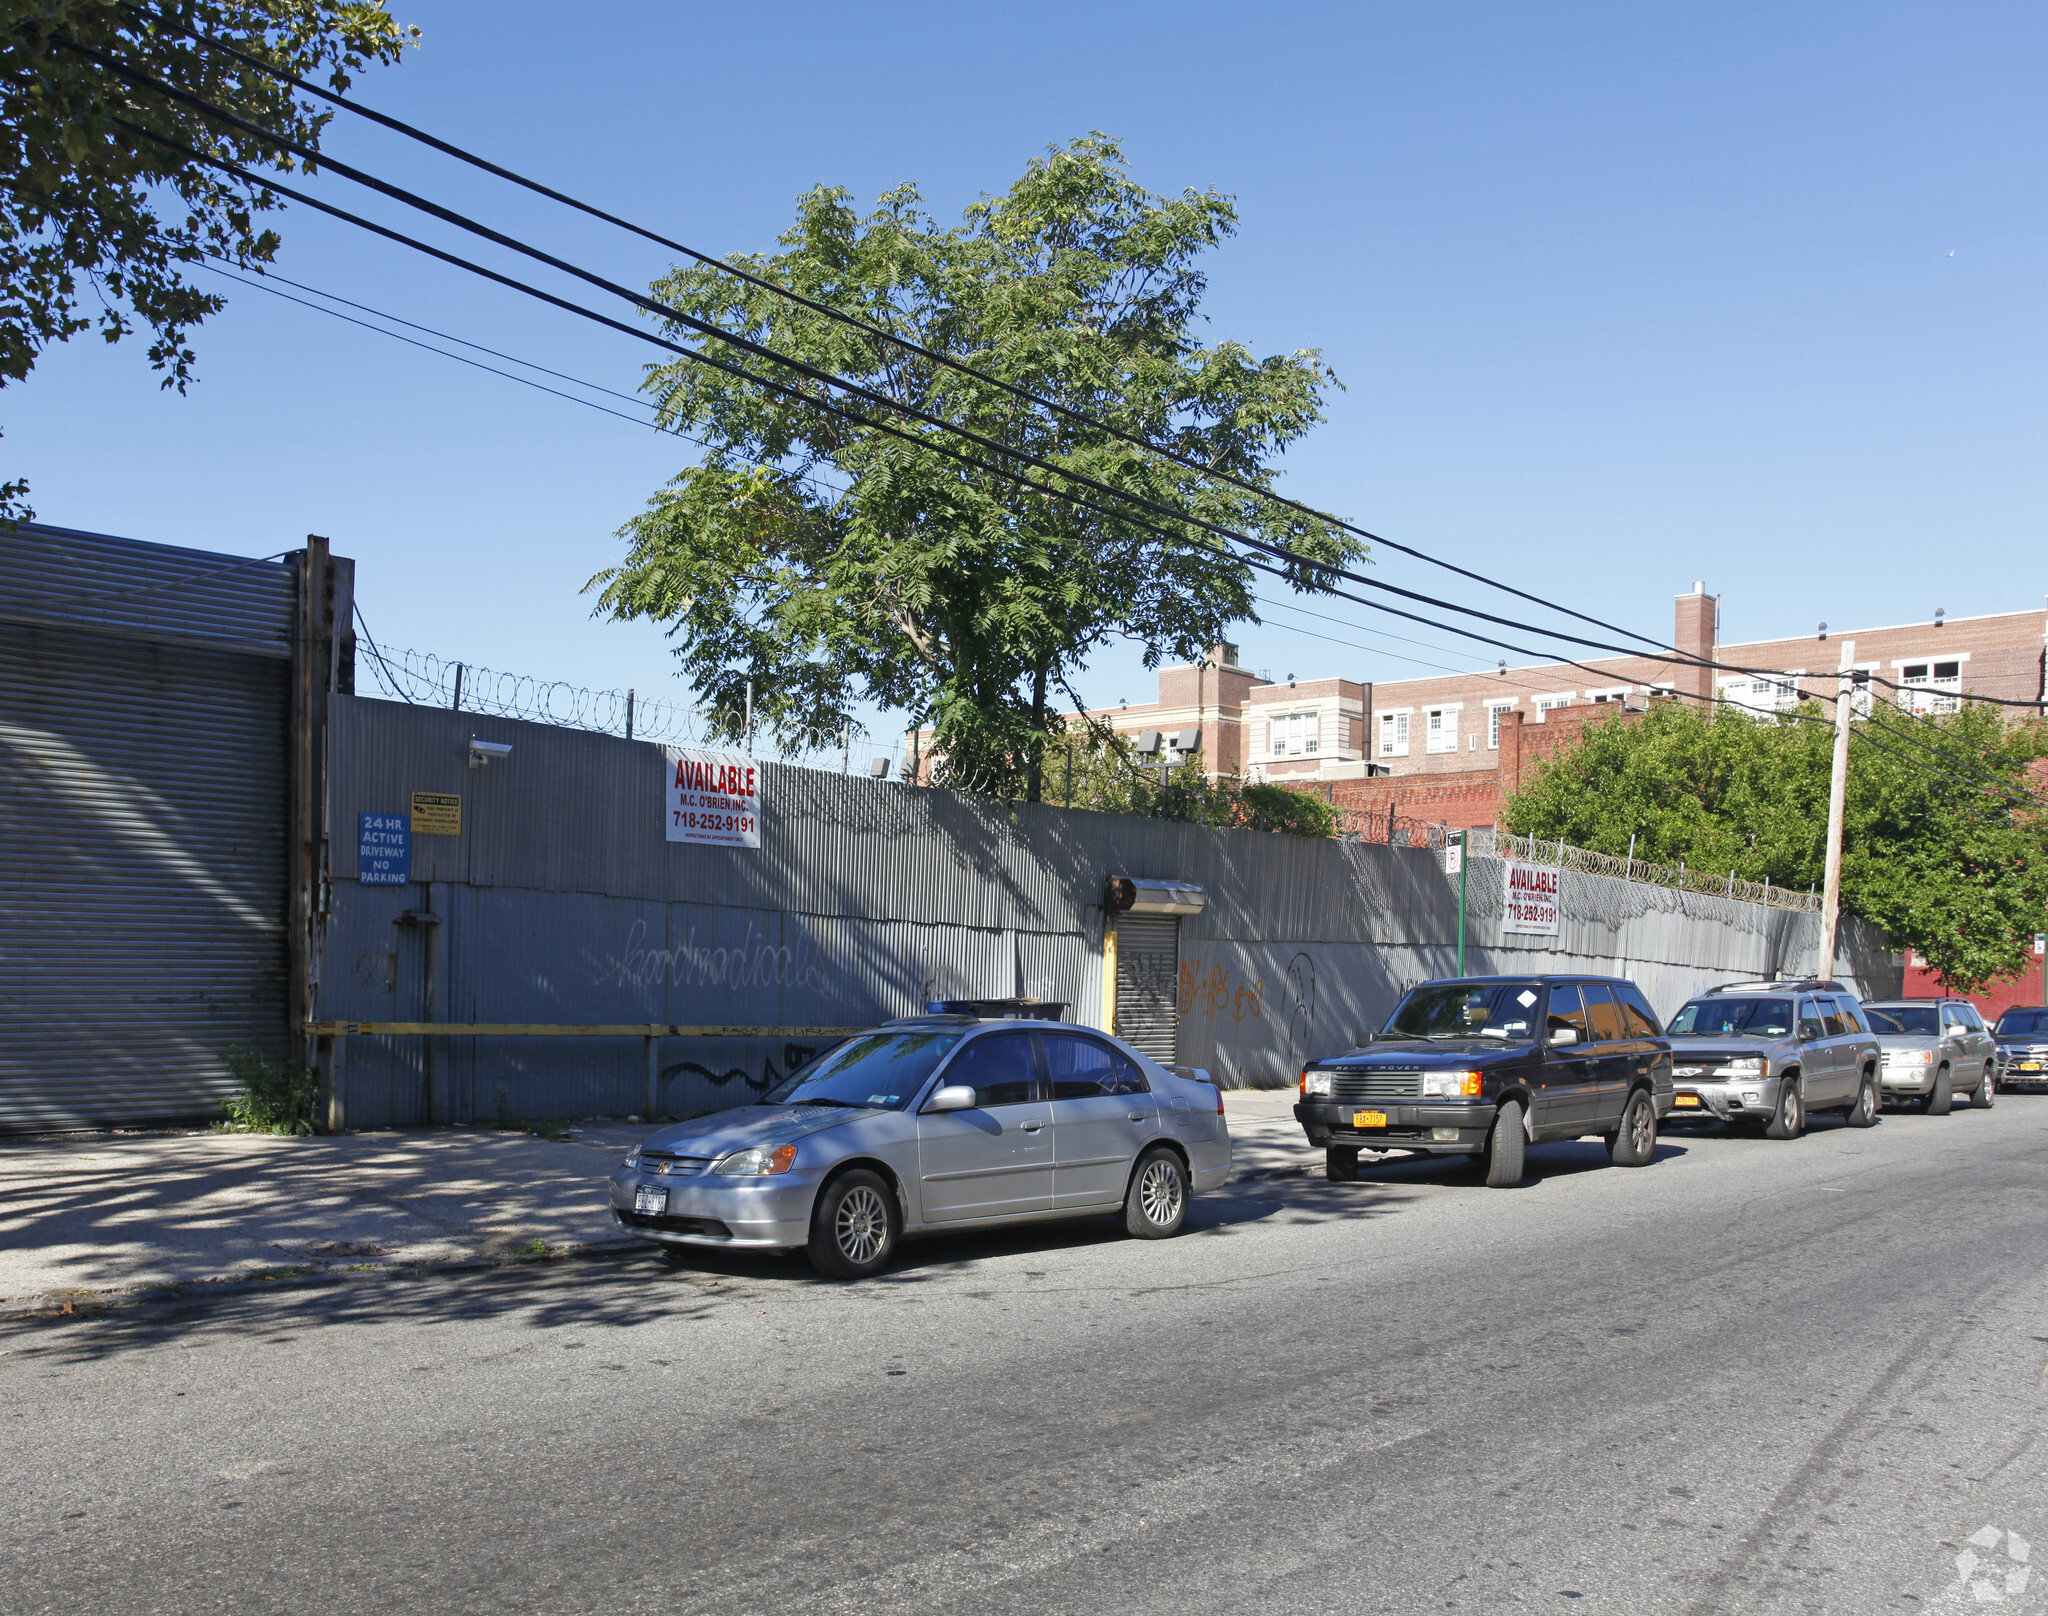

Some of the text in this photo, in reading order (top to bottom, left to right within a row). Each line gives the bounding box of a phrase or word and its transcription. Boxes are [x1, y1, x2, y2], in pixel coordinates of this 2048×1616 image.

[675, 759, 755, 797] AVAILABLE
[415, 796, 458, 806] SECURITY NOTICE
[680, 793, 697, 807] M.C.
[364, 816, 405, 831] 24 HR.
[673, 810, 754, 833] 718-252-9191
[362, 832, 404, 845] ACTIVE
[360, 845, 405, 858] DRIVEWAY
[373, 861, 390, 870] NO
[361, 872, 406, 883] PARKING
[1509, 868, 1557, 894] AVAILABLE
[1512, 891, 1522, 901] M.C.
[1508, 903, 1557, 923] 718-252-9191
